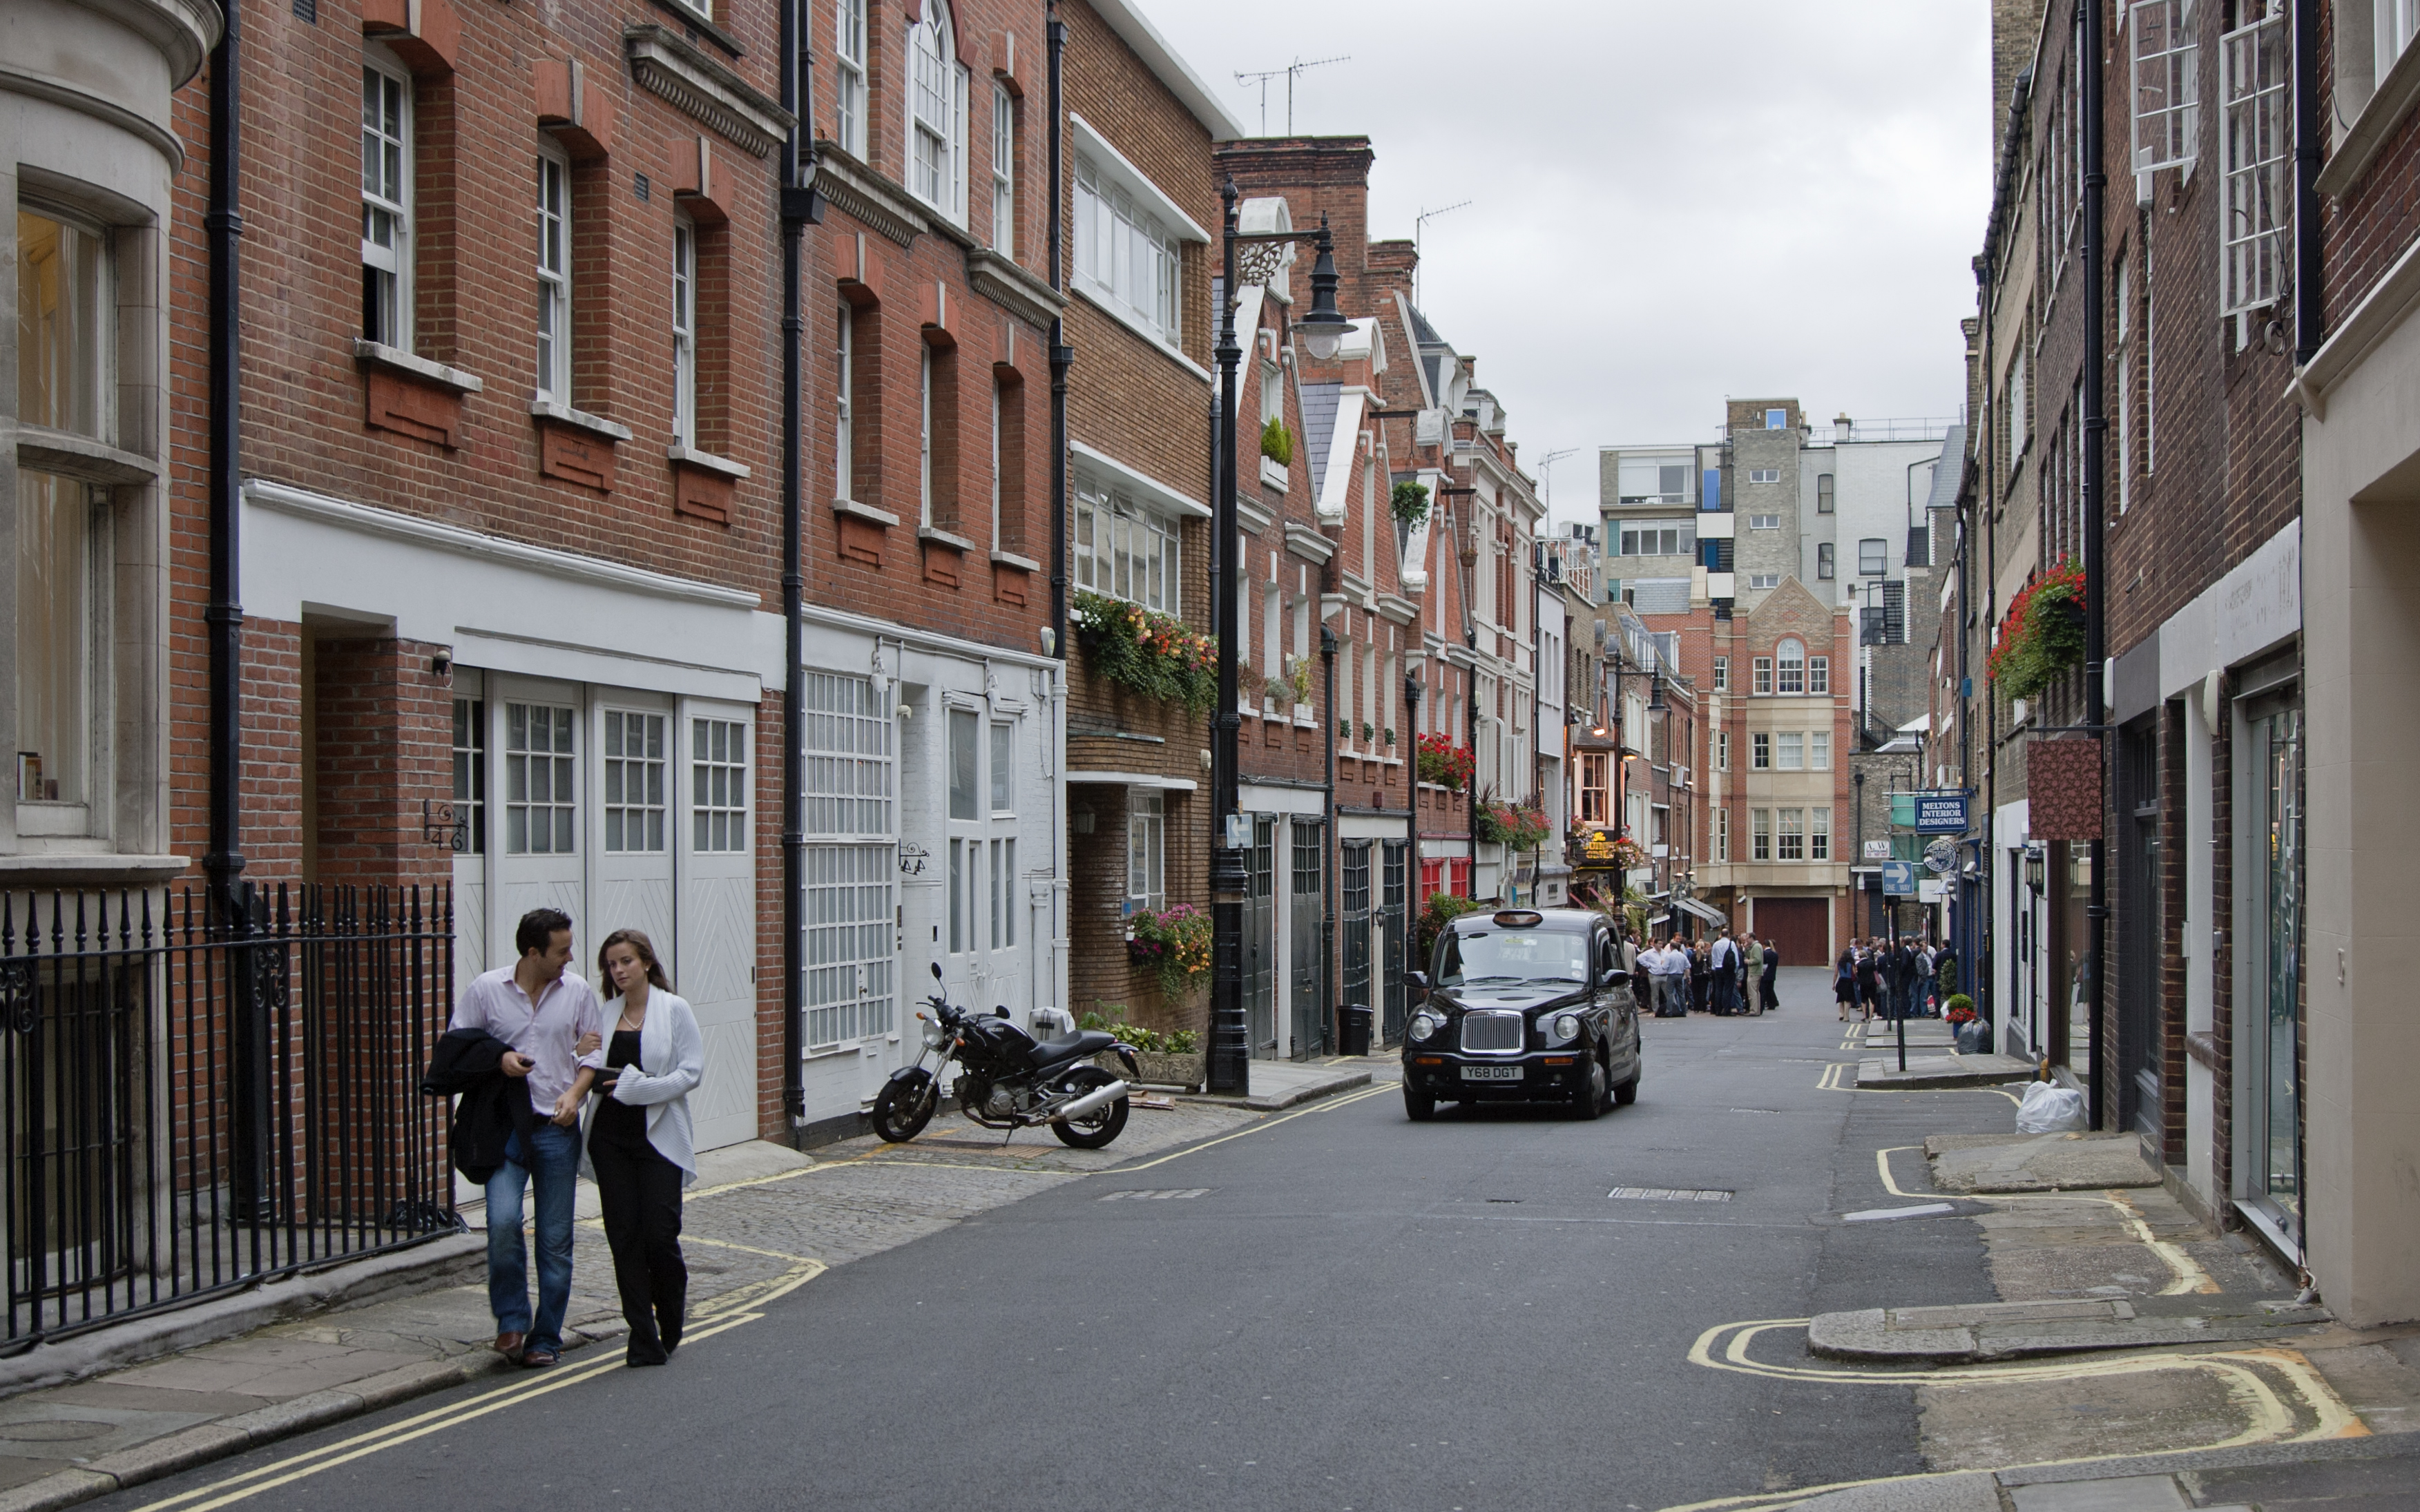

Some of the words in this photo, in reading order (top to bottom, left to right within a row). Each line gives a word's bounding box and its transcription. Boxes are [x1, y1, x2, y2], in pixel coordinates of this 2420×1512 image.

[1922, 802, 1960, 810] MELTONS
[1922, 809, 1961, 817] INTERIOR
[1919, 817, 1965, 826] DESIGNERS
[431, 831, 463, 851] 46
[1466, 1067, 1490, 1078] Y68
[1493, 1067, 1517, 1078] DGT
